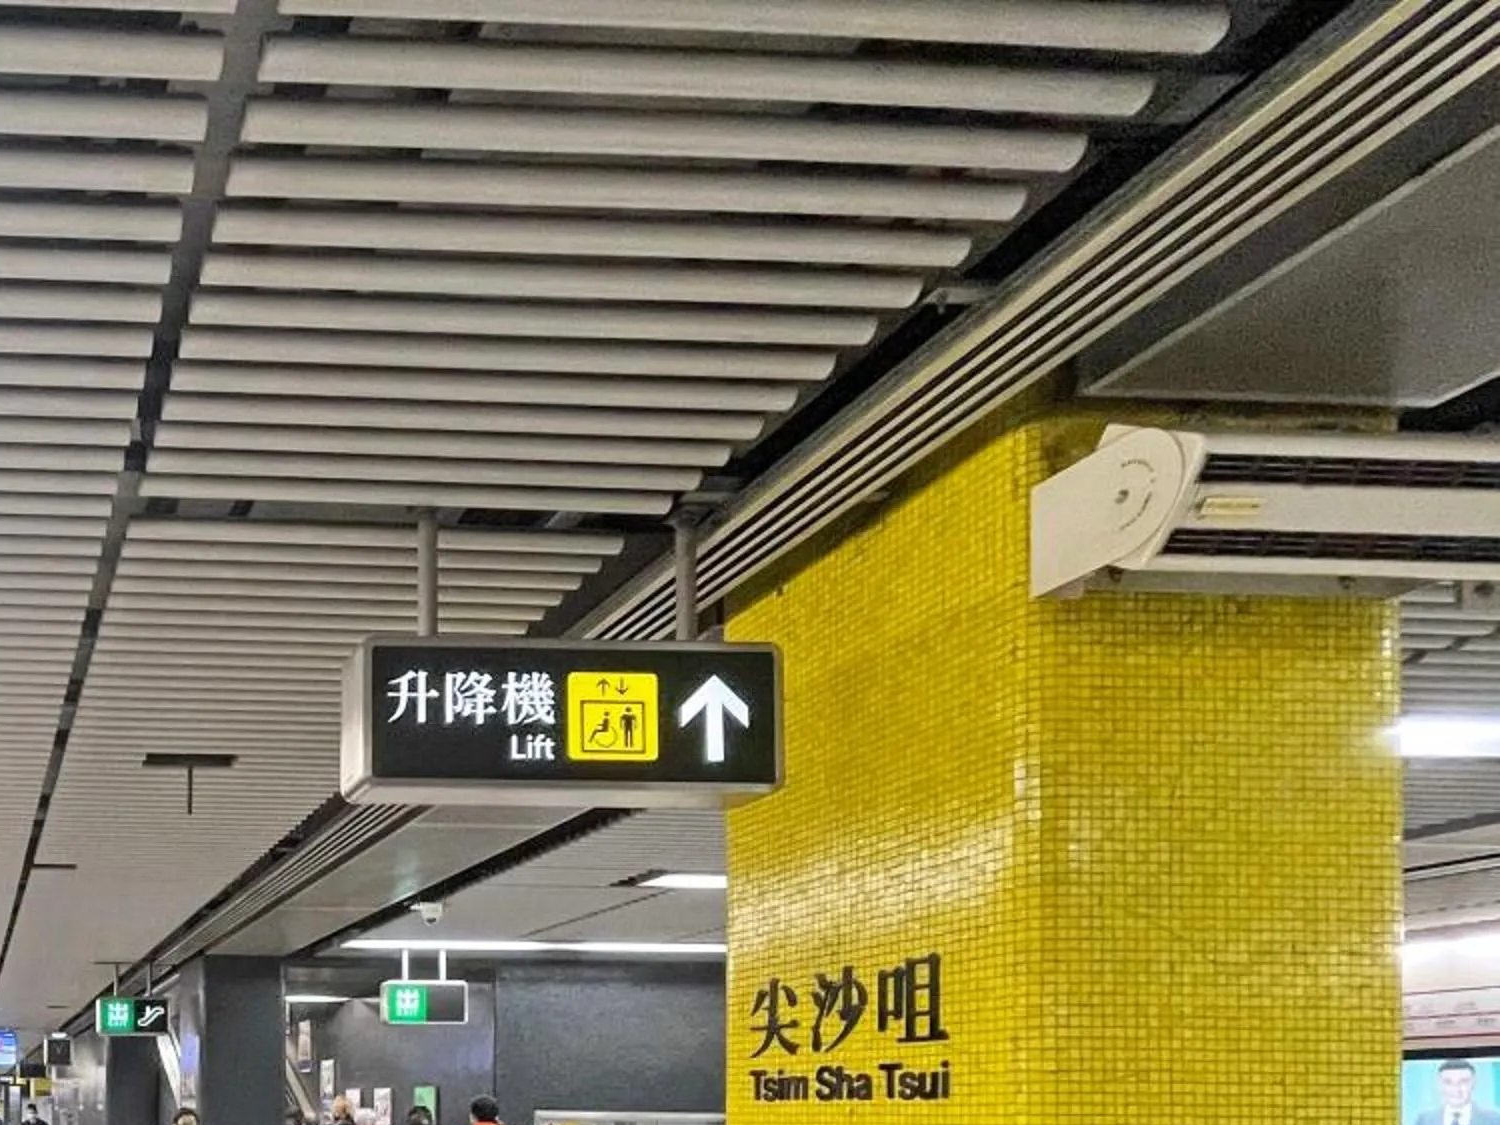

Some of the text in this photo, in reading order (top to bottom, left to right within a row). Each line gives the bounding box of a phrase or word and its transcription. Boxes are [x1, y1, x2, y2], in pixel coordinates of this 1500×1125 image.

[386, 669, 557, 727] 升降機
[510, 734, 556, 761] Lift
[748, 952, 950, 1060] 尖沙咀
[748, 1060, 951, 1102] Tsim Sha Tsui
